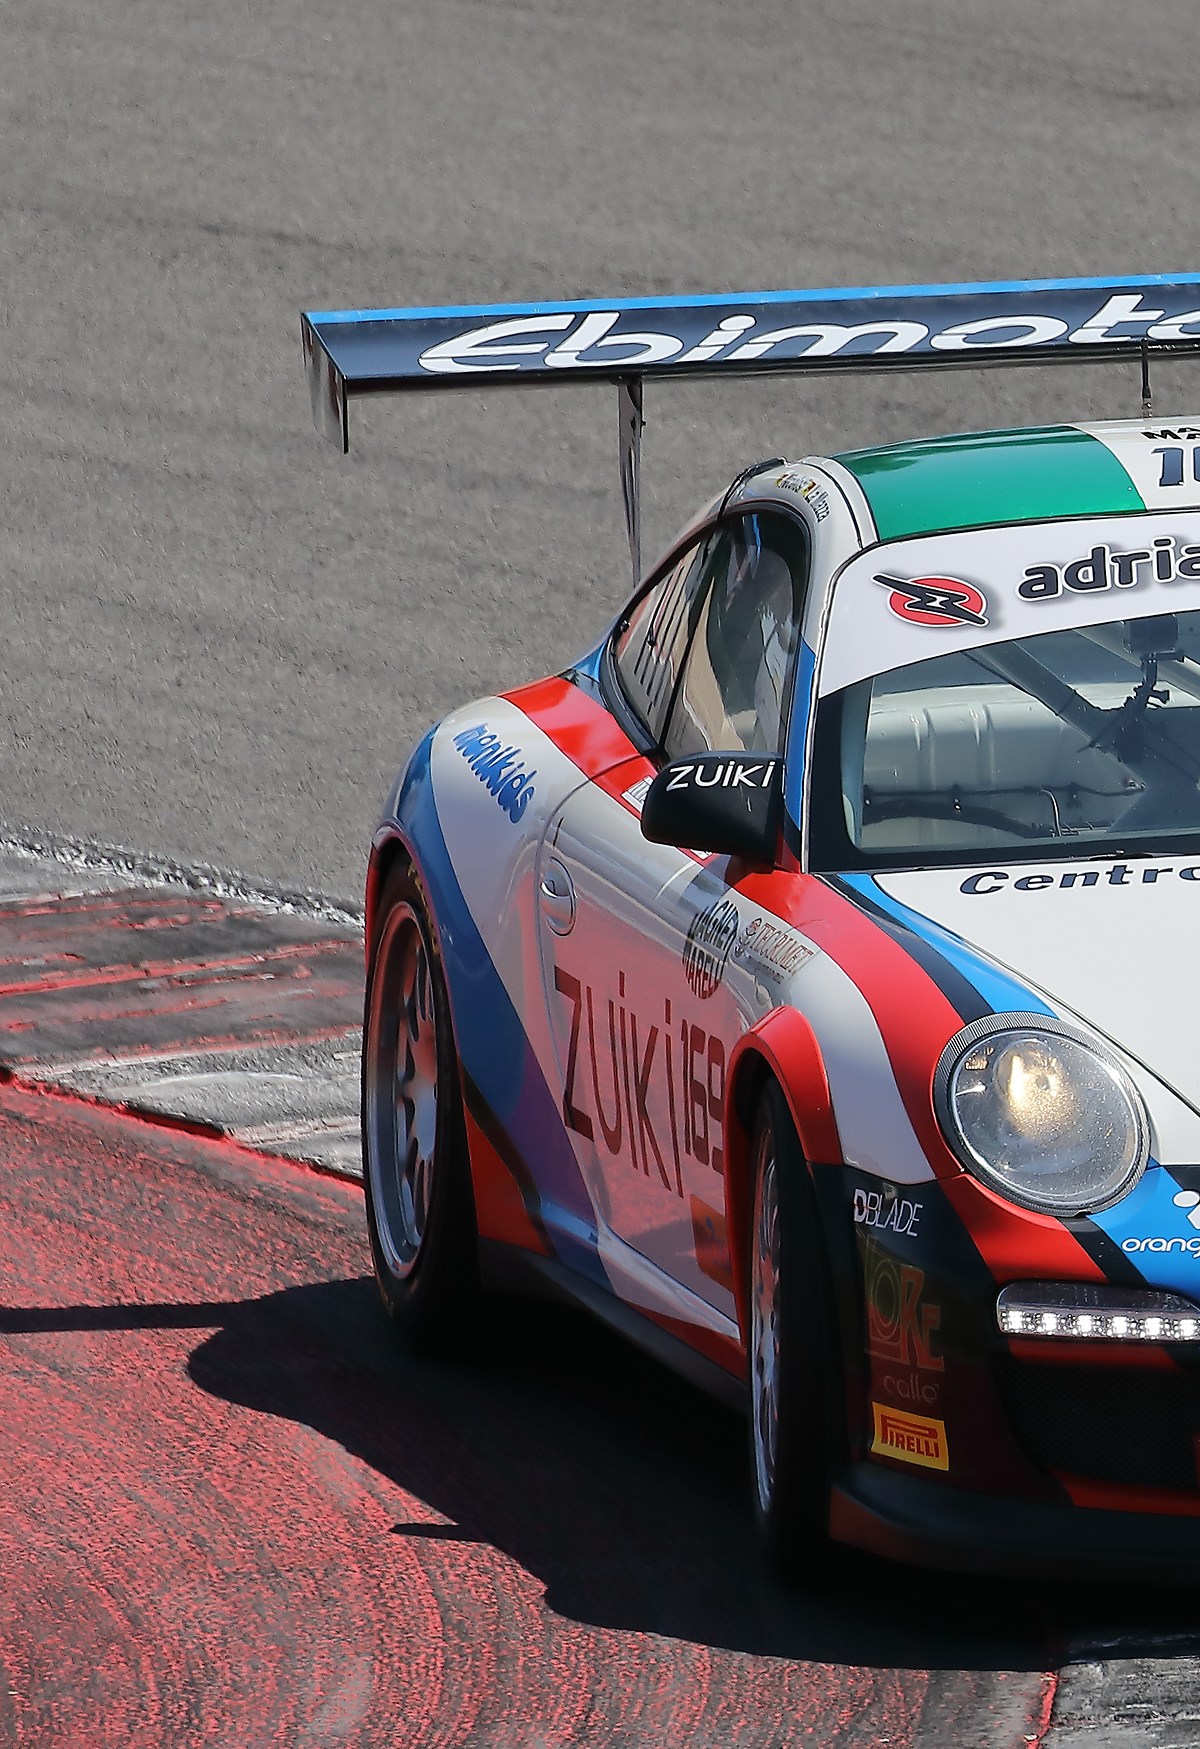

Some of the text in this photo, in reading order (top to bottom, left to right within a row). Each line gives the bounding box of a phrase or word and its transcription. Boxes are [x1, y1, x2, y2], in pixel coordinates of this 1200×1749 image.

[680, 1019, 725, 1176] 169
[853, 1188, 924, 1237] DBLADE
[880, 1413, 940, 1459] PIRELLI
